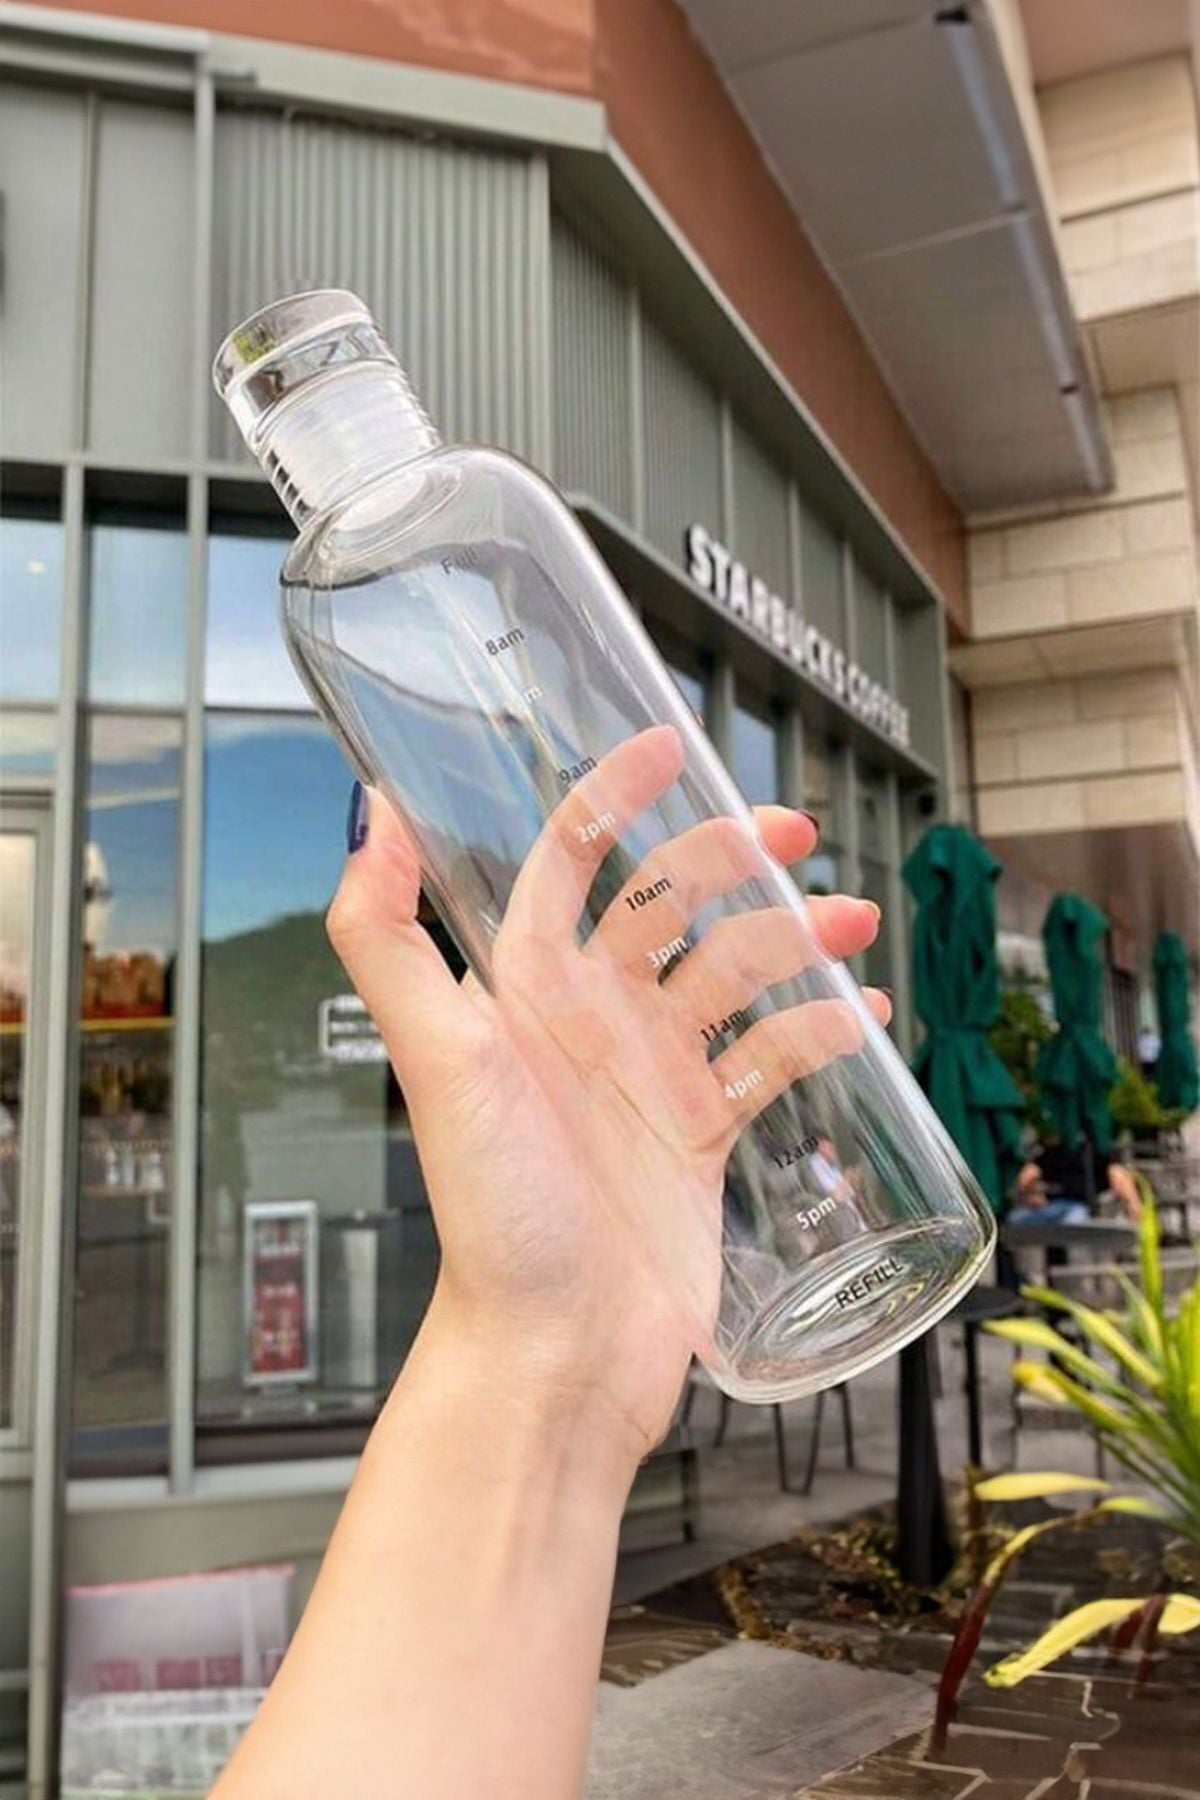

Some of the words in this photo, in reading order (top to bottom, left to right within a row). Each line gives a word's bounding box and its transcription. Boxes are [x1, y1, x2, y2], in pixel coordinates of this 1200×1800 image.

[687, 523, 846, 697] STARBUCKS
[485, 627, 525, 656] 8am
[559, 756, 598, 788] 9am
[576, 811, 616, 844] 2pm
[625, 876, 672, 911] 10am
[647, 935, 688, 968] 3pm
[700, 1007, 746, 1043] 11am
[724, 1068, 764, 1100] 4pm
[772, 1134, 819, 1170] 12am
[796, 1196, 838, 1231] 5pm
[834, 1257, 904, 1309] REFILL
